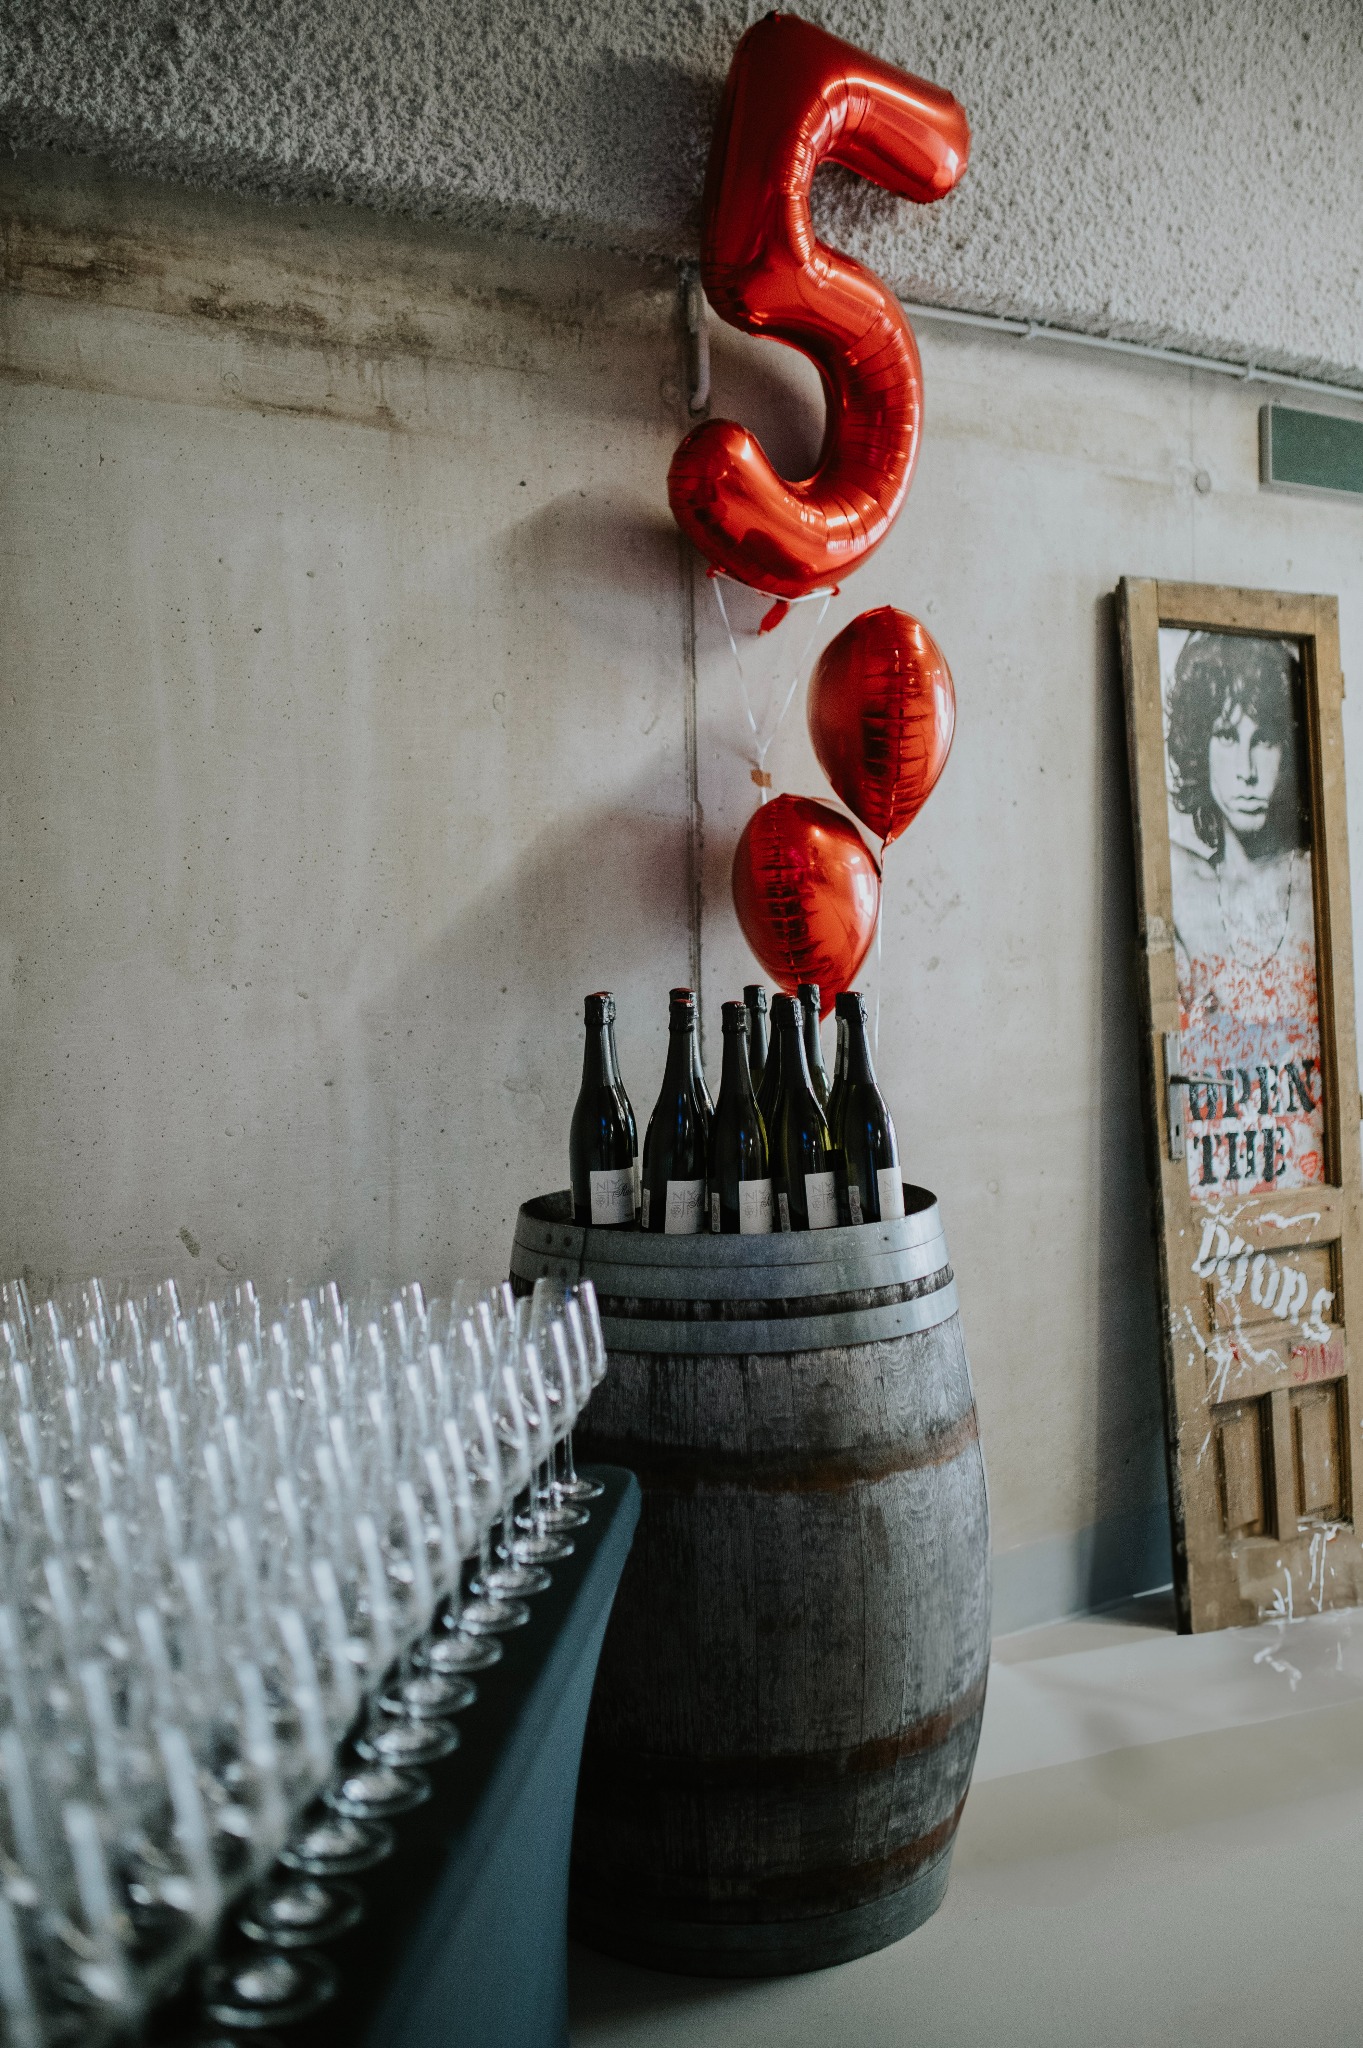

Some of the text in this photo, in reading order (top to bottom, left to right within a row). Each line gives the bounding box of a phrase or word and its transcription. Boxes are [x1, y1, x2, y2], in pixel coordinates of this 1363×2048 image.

[667, 11, 971, 602] 5
[1189, 1060, 1315, 1120] OPEN
[1194, 1127, 1286, 1186] THE
